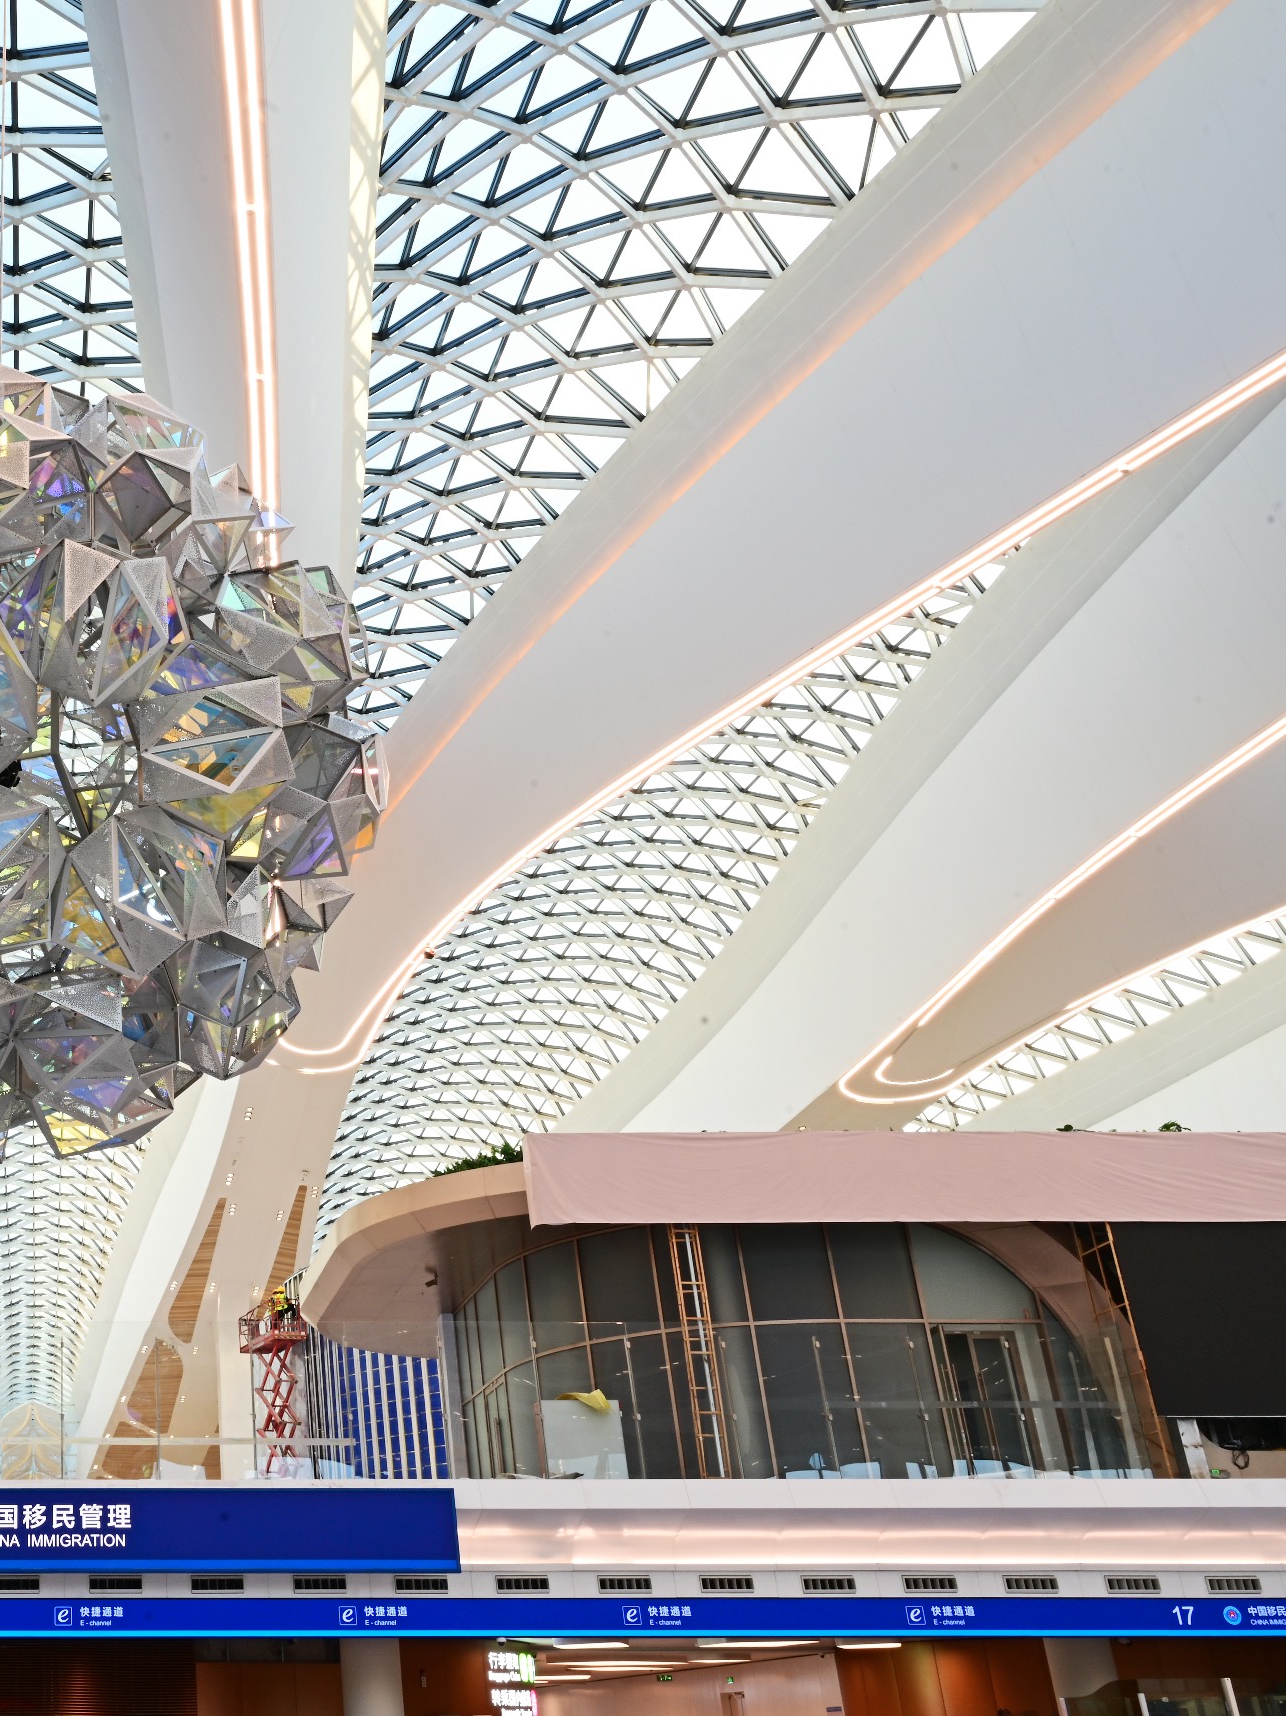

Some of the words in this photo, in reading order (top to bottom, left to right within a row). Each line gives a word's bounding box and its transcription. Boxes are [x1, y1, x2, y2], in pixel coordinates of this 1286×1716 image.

[27, 1534, 126, 1548] IMMIGRATION
[79, 1606, 124, 1617] 快捷通道
[364, 1606, 408, 1617] 快捷通道
[647, 1606, 692, 1617] 快捷通道
[930, 1606, 976, 1617] 快捷通道
[1172, 1605, 1194, 1626] 17
